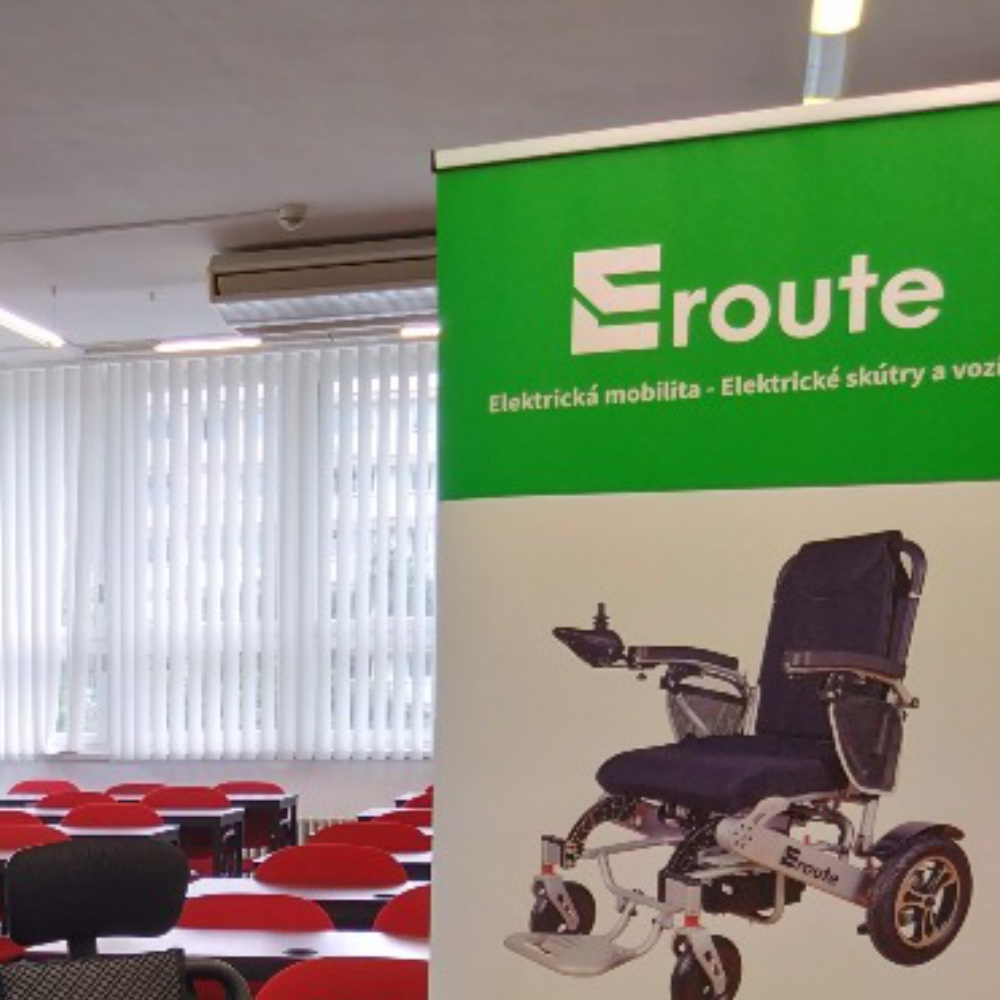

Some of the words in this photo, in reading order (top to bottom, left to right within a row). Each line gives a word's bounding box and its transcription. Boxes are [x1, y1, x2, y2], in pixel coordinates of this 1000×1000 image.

[571, 244, 944, 355] Eroute
[489, 384, 599, 413] Elektrická
[605, 379, 700, 405] mobilita
[721, 365, 840, 396] Elektrické
[846, 362, 926, 389] skútry
[932, 364, 946, 381] a
